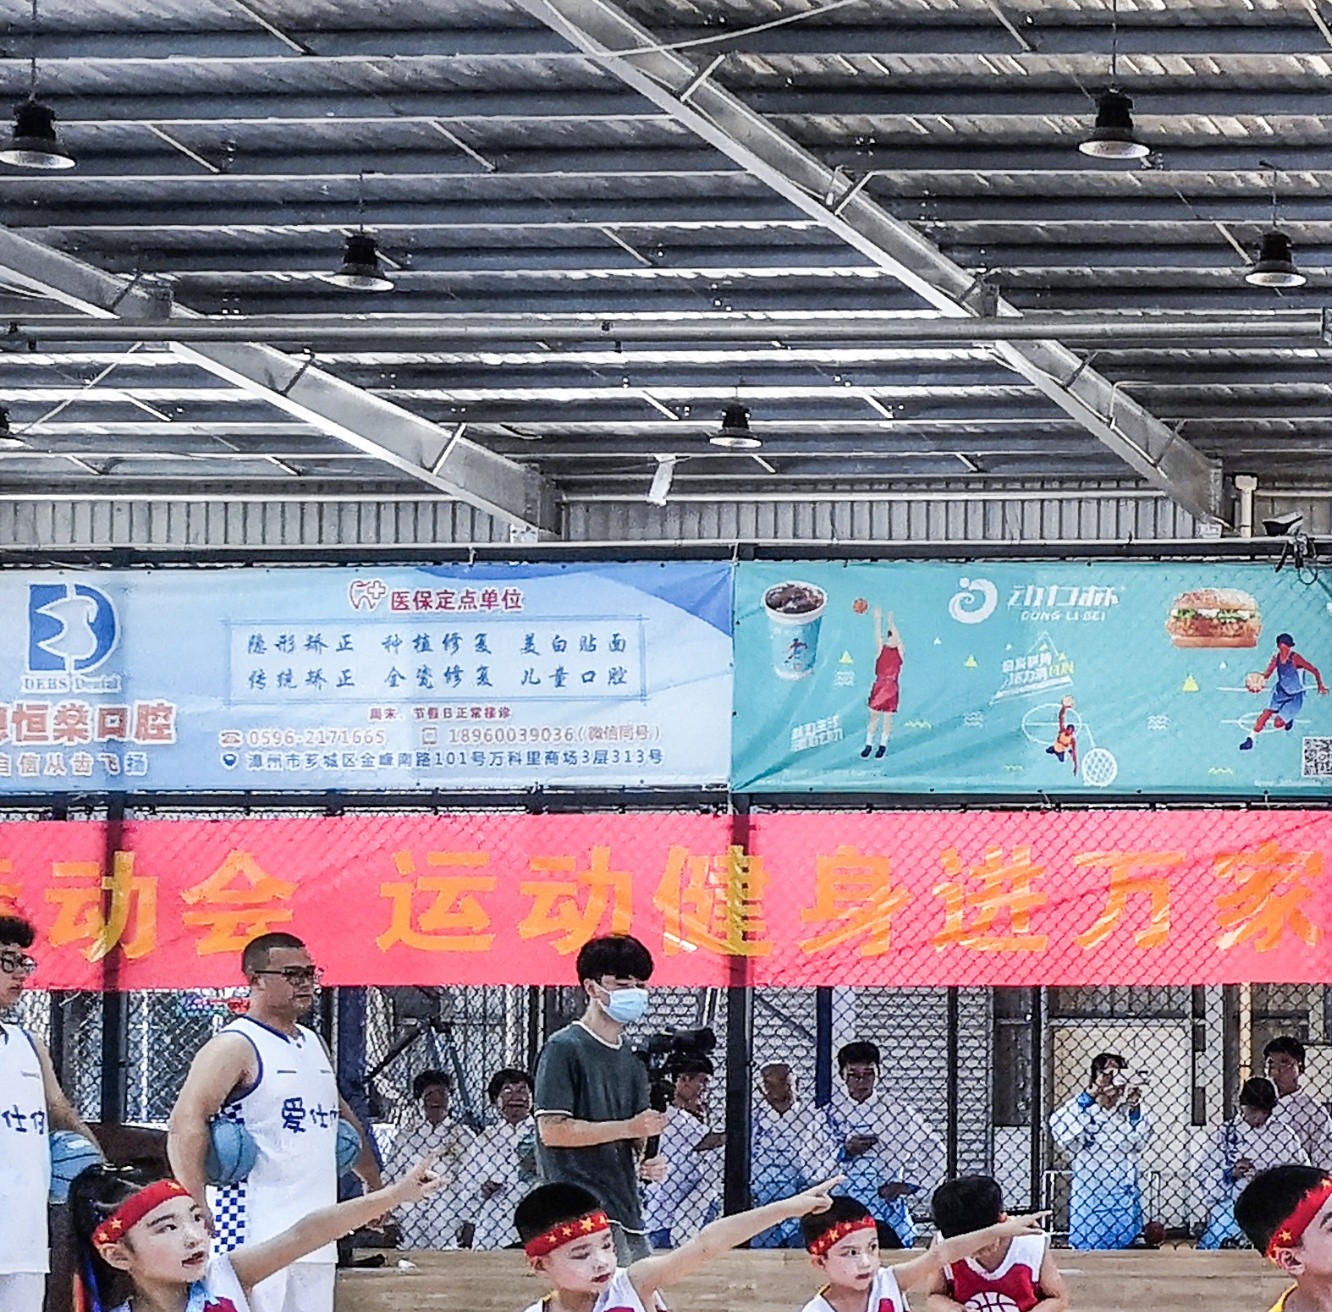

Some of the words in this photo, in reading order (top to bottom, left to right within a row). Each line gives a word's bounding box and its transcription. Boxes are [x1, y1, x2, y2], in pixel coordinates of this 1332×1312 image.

[390, 589, 524, 612] 医保定点单位
[247, 634, 355, 654] 隐形矫正
[381, 633, 493, 655] 种植修复
[520, 633, 627, 654] 美白贴面
[247, 667, 356, 690] 传统矫正
[383, 666, 493, 690] 全瓷修复
[520, 667, 628, 688] 儿童口腔
[0, 849, 299, 962] 动会
[376, 845, 1325, 960] 运动健身进万家
